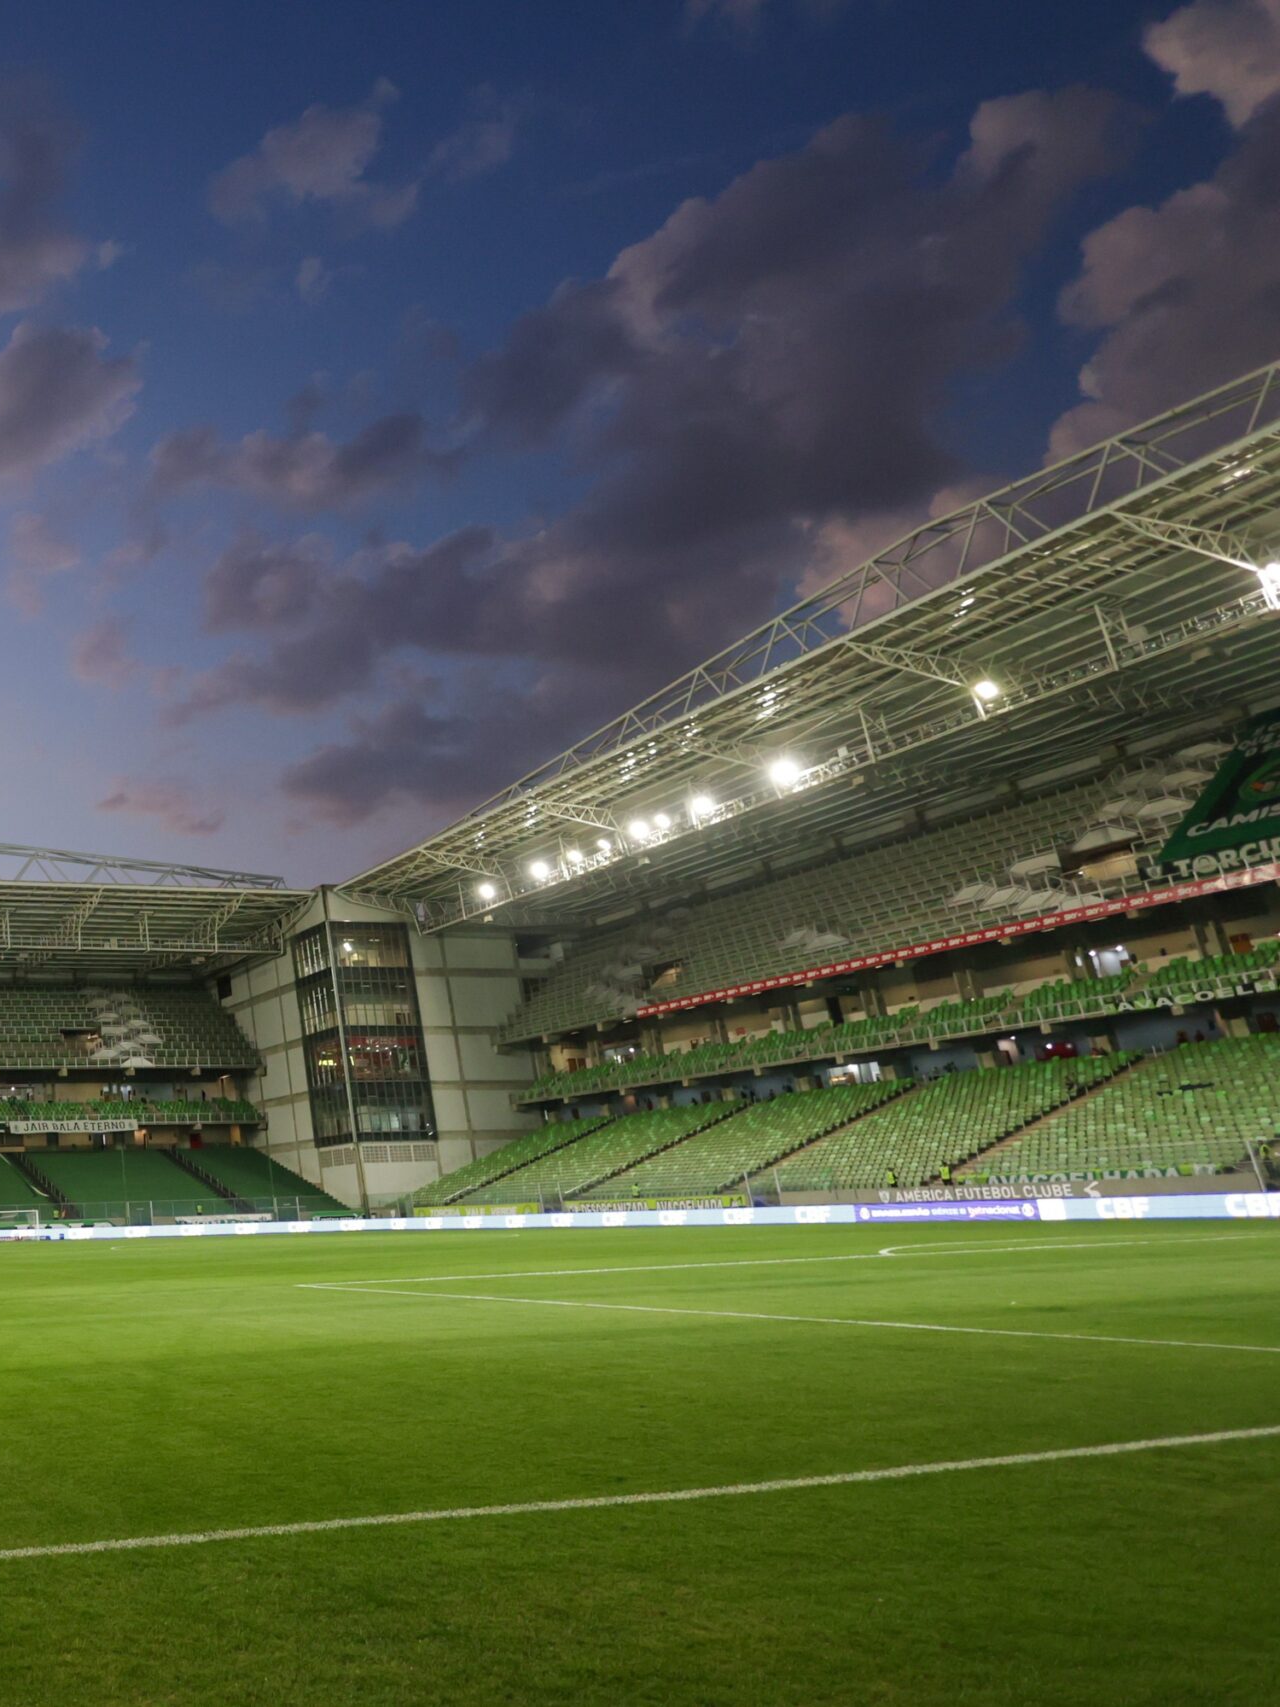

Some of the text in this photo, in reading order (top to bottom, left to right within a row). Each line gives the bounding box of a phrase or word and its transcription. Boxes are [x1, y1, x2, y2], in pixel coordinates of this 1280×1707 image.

[24, 1121, 126, 1132] JAIR BALA ETERNO
[895, 1183, 1073, 1203] AMÉRICA FUTEBOL CLUBE
[1096, 1197, 1149, 1218] CBF
